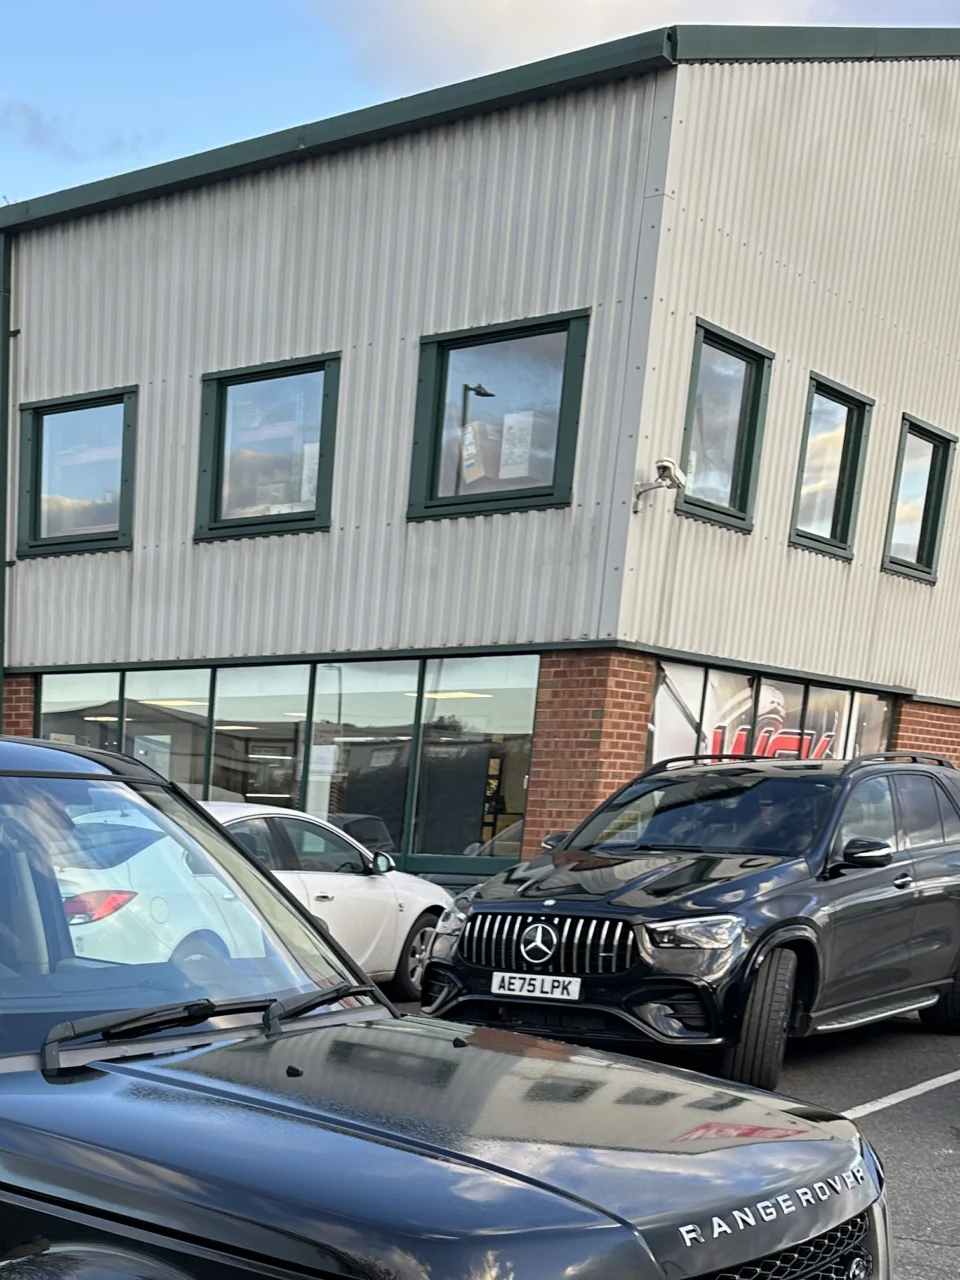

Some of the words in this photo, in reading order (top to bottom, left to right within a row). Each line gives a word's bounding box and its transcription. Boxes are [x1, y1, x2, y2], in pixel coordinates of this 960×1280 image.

[498, 975, 537, 993] AE75
[540, 978, 572, 996] LPK
[678, 1193, 796, 1246] RANGE
[795, 1166, 866, 1207] ROVER
